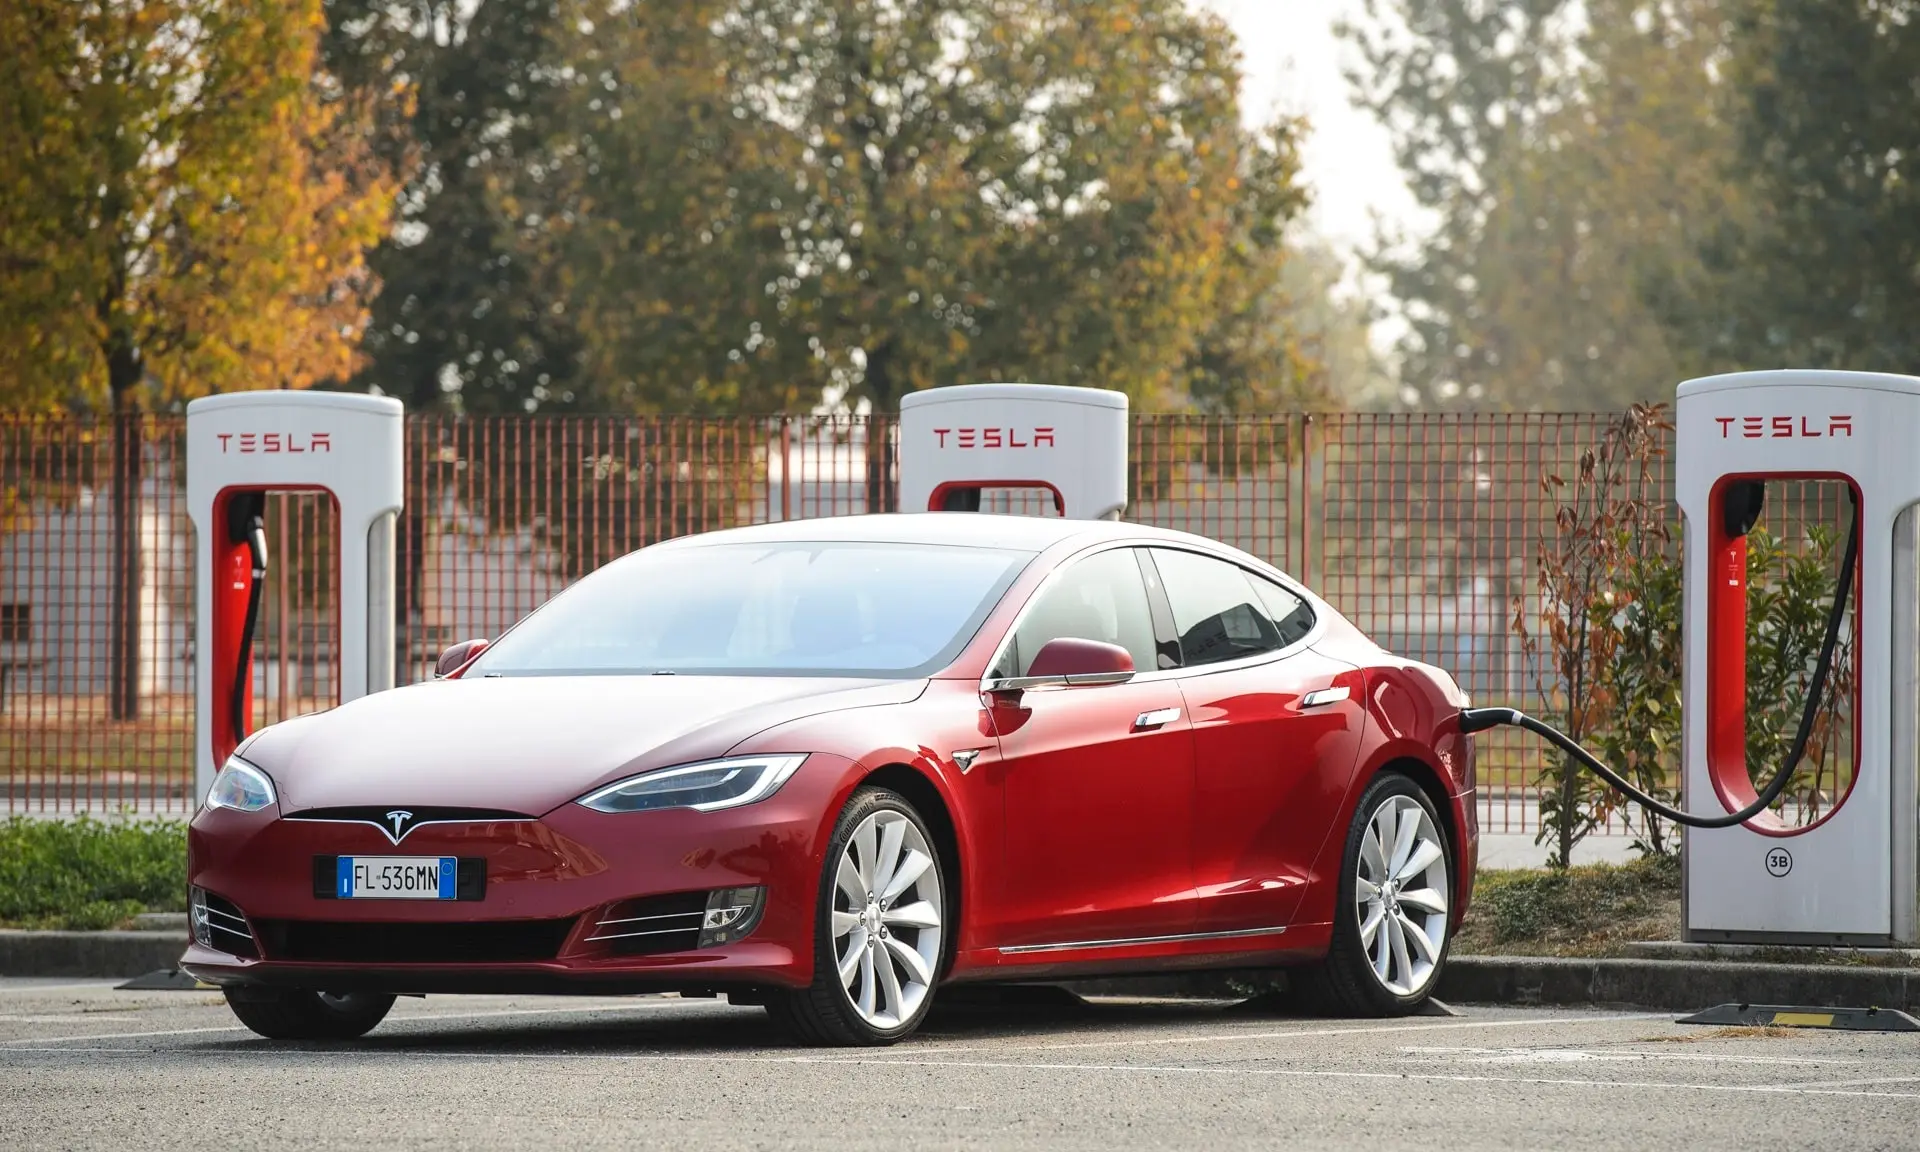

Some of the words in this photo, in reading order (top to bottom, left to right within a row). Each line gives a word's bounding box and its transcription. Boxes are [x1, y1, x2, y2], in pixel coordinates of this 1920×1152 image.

[1715, 415, 1853, 438] TESLA
[217, 433, 330, 453] TESLA
[933, 427, 1055, 449] TESLA
[839, 802, 870, 844] Continental
[1770, 855, 1788, 868] 3B
